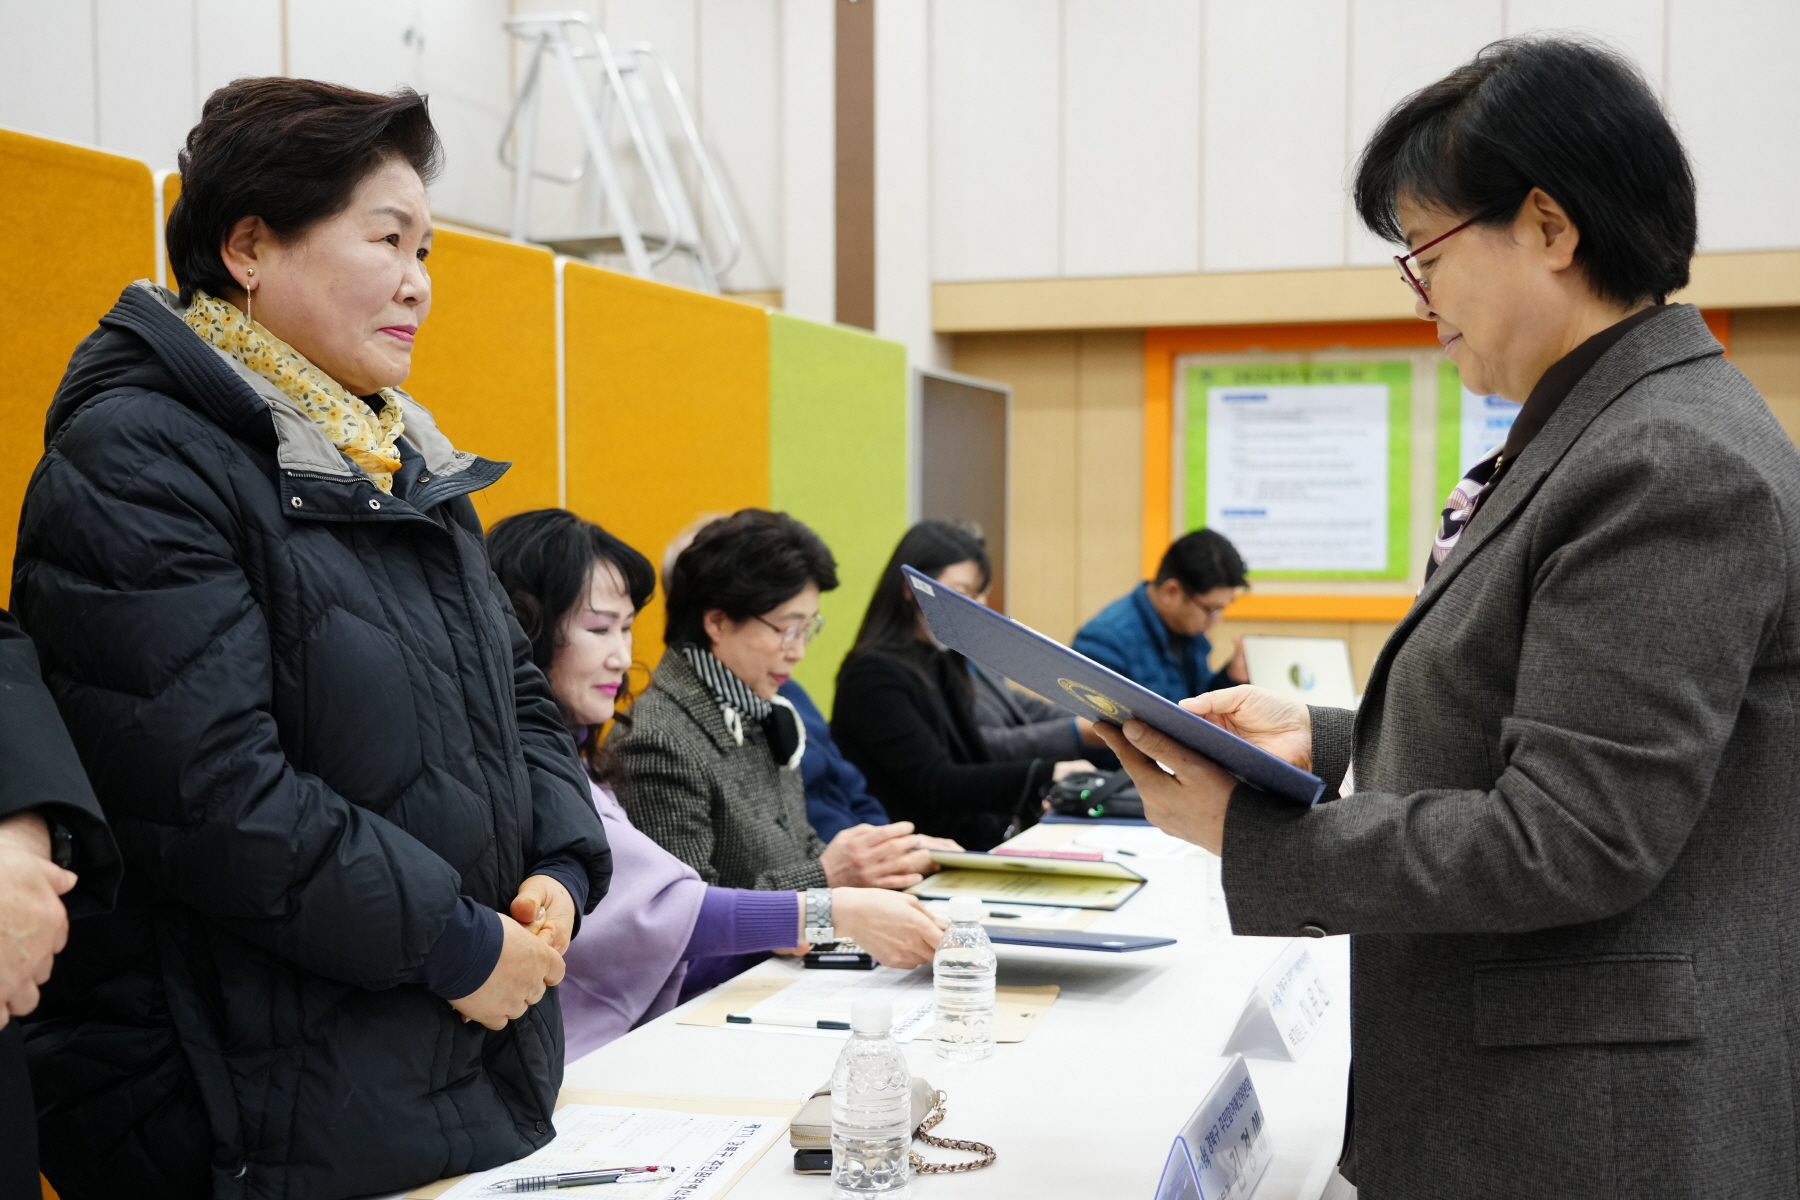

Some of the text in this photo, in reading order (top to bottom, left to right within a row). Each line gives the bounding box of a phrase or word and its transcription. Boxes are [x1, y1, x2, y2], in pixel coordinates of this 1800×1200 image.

[735, 1123, 762, 1138] 제7기
[1204, 1124, 1221, 1154] 강북구
[716, 1140, 746, 1158] 강북구
